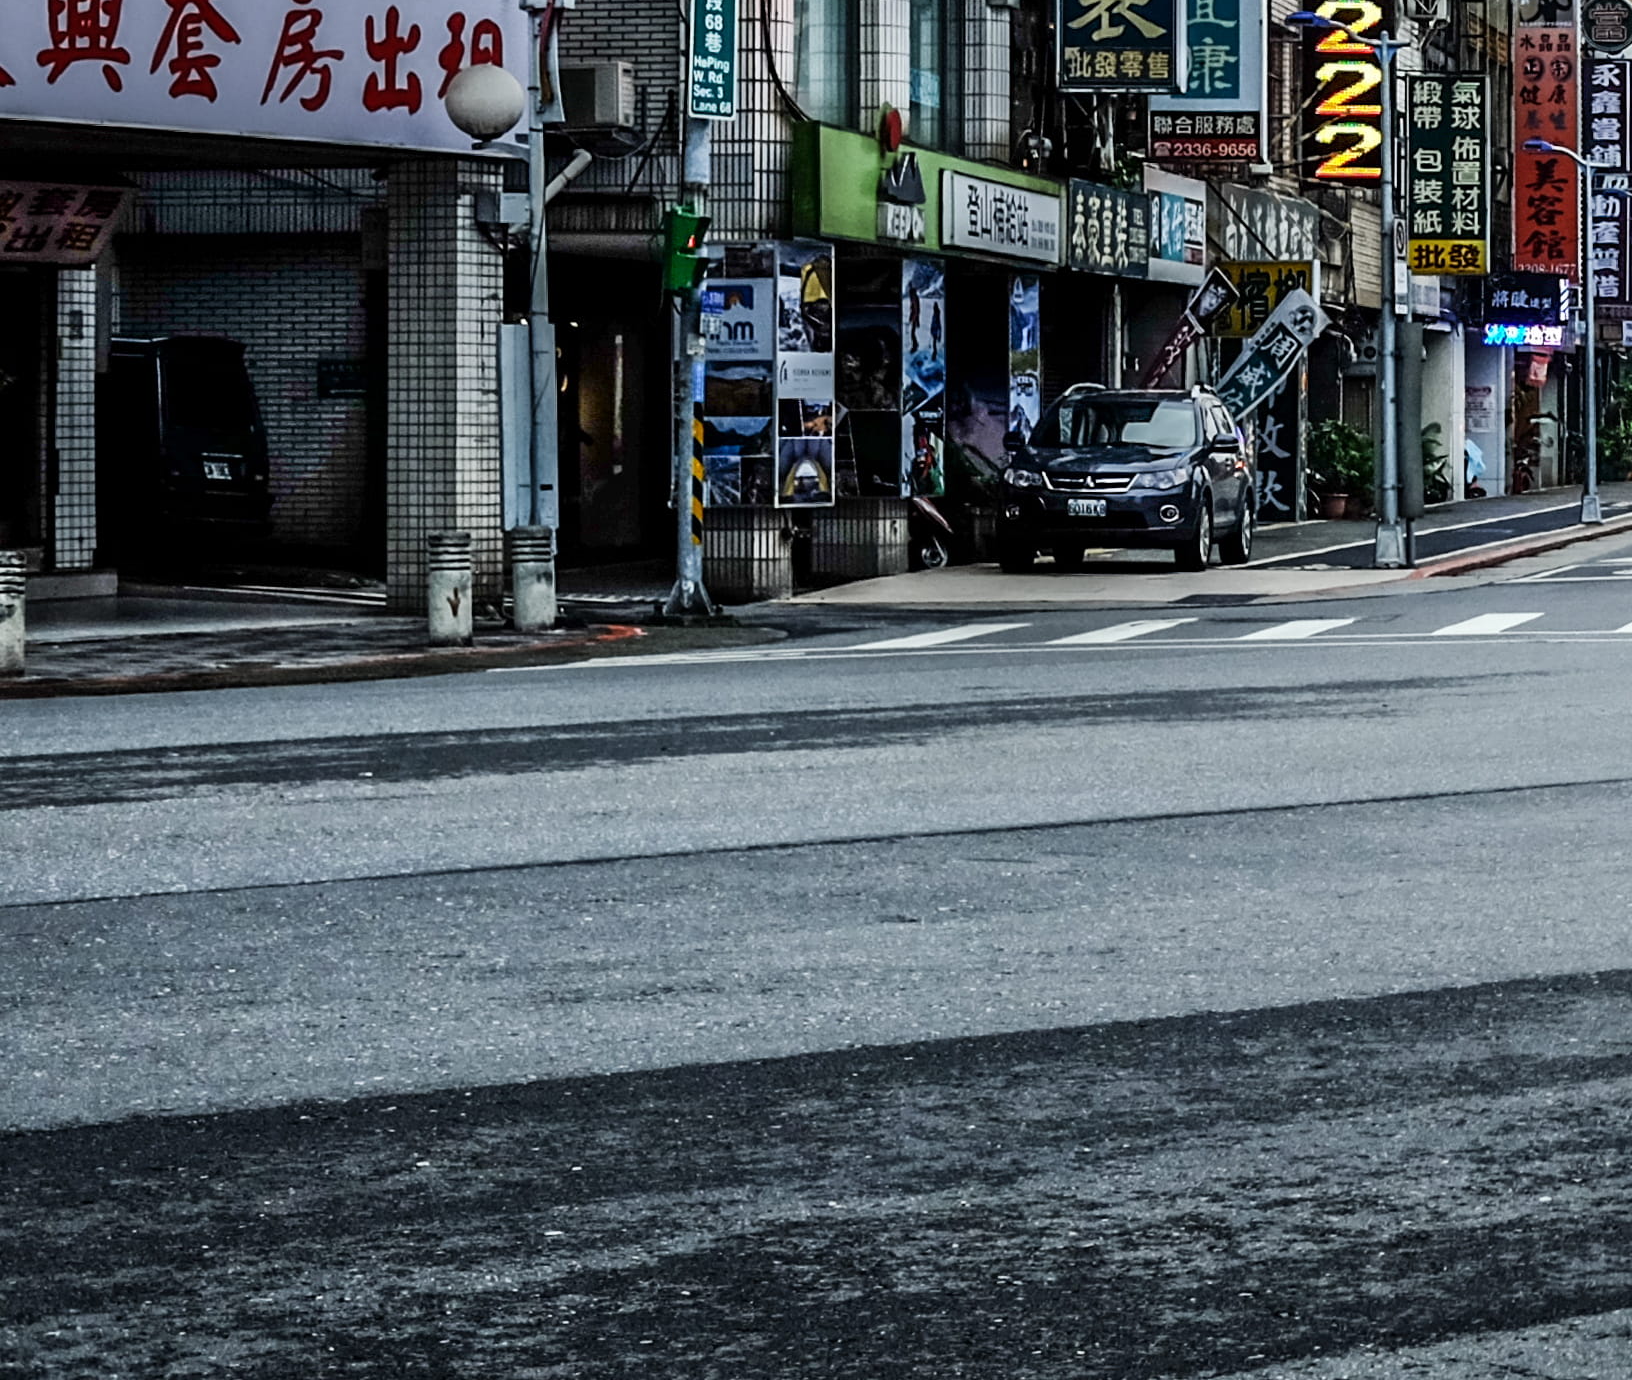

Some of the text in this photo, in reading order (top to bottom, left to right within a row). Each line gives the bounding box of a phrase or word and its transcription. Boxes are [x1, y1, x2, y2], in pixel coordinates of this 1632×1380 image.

[1068, 51, 1169, 79] 批發零售
[693, 87, 724, 98] Sec. 3
[693, 100, 731, 114] Lane 68
[1153, 116, 1255, 135] 聯合服務處
[1173, 144, 1257, 157] 2336-9656
[1413, 244, 1481, 270] 批發
